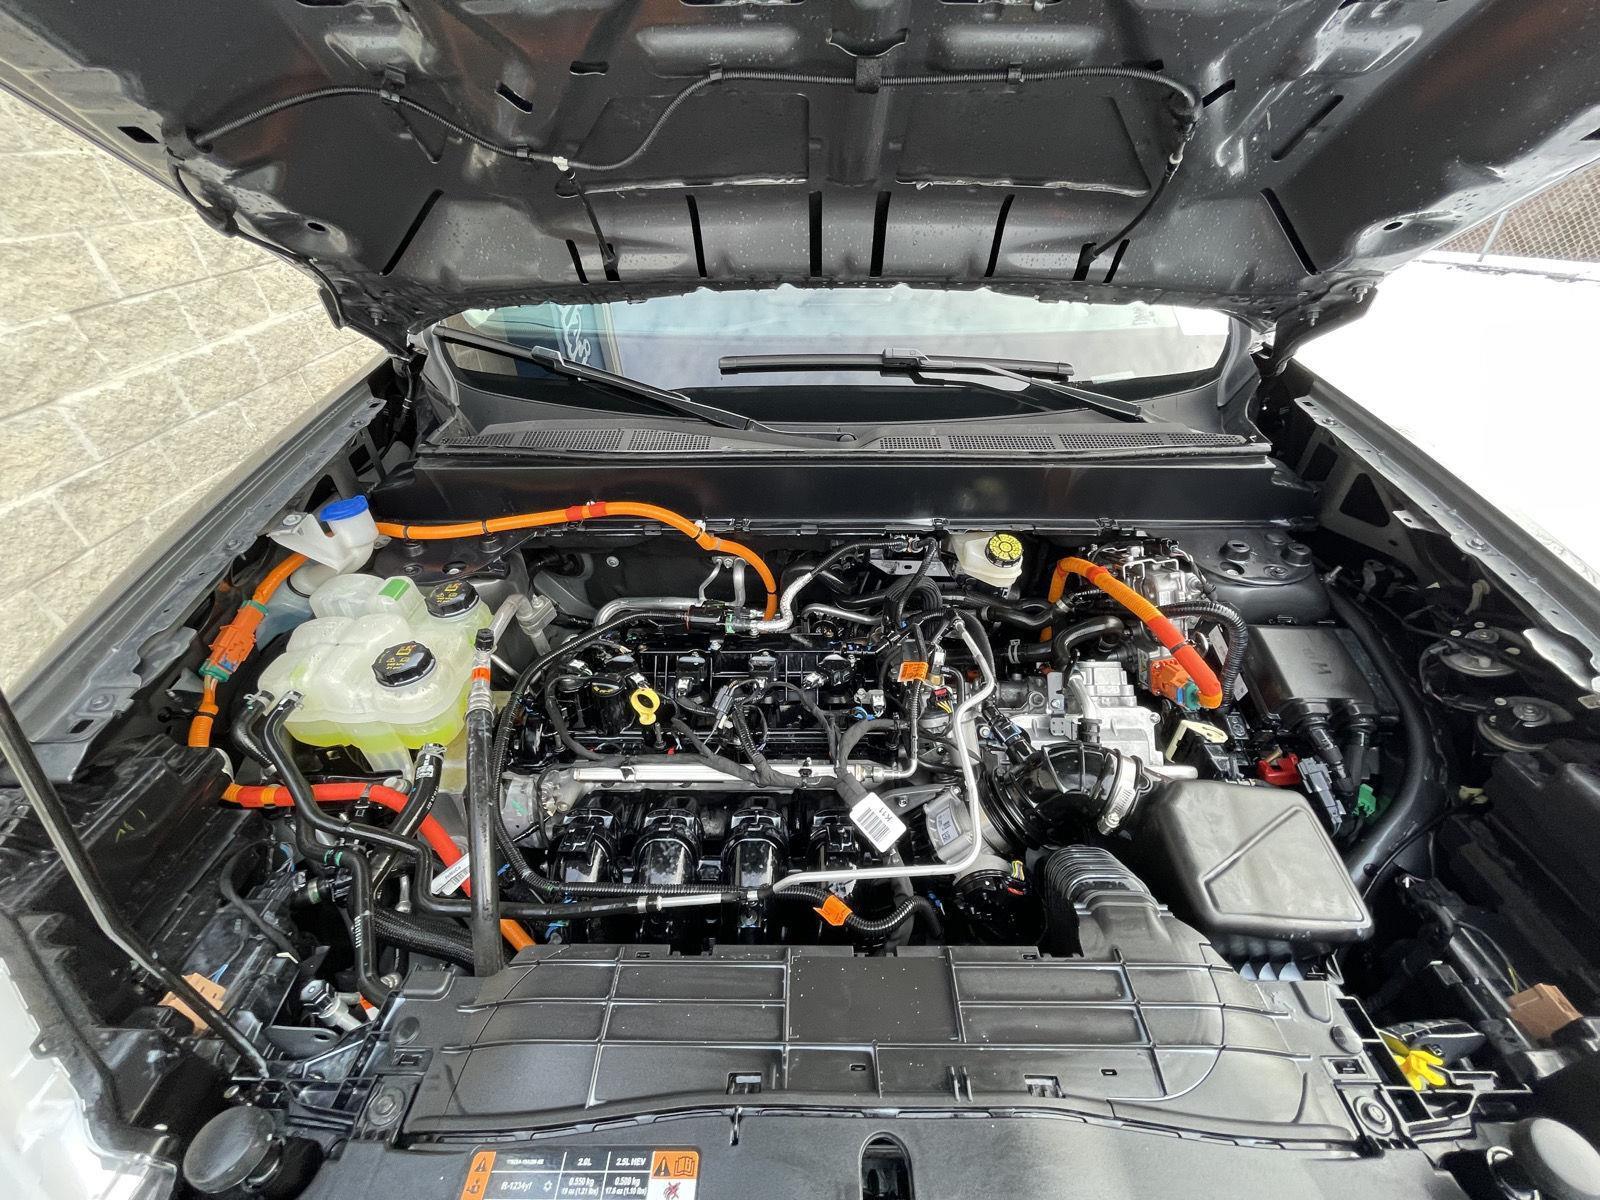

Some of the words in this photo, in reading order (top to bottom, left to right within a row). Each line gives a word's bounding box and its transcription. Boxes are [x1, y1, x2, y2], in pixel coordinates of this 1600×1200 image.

[577, 1157, 592, 1167] 2.0L
[616, 1157, 630, 1166] 2.5L
[631, 1157, 647, 1166] HEV
[586, 1177, 595, 1187] kg
[631, 1177, 641, 1187] kg
